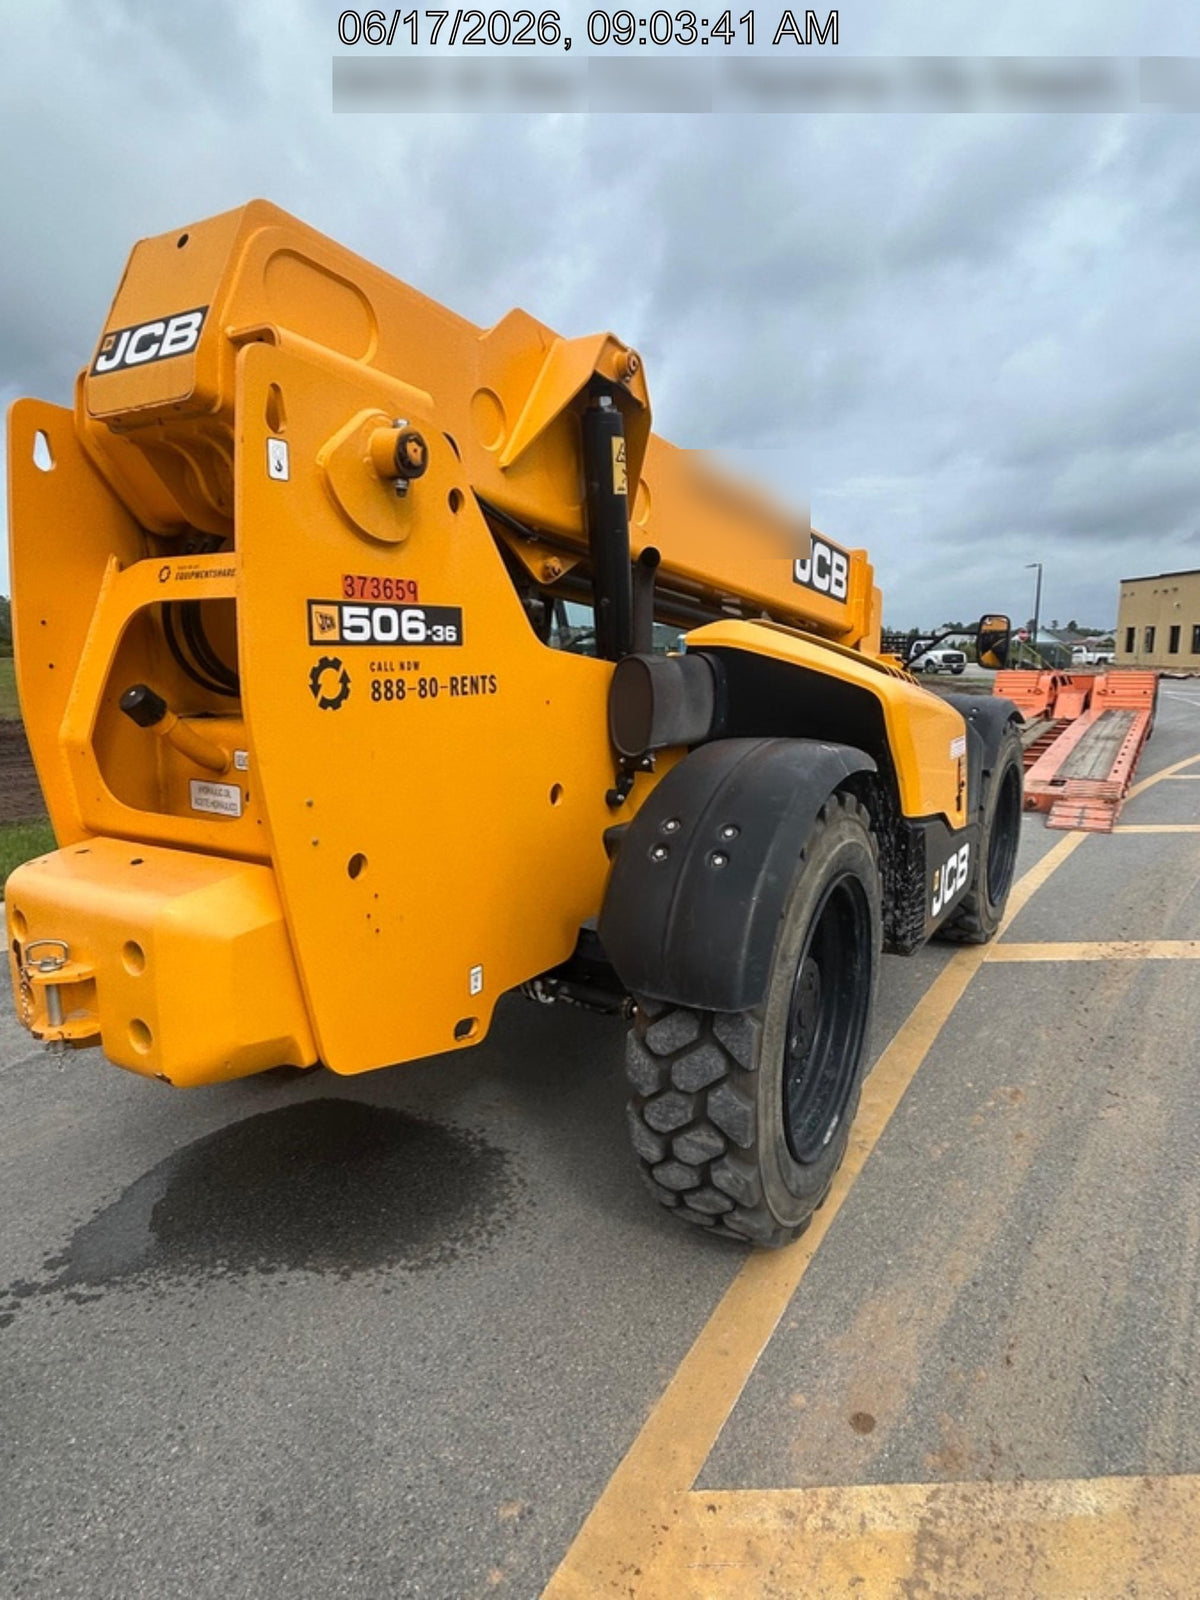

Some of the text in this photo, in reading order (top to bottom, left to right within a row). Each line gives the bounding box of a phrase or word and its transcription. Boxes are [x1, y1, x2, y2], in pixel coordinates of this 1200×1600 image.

[95, 311, 203, 372] JCB
[344, 575, 418, 601] 373659
[795, 541, 848, 599] JCB
[369, 661, 420, 673] CALL NOW
[371, 674, 498, 702] 888-80-RENTS
[931, 842, 970, 917] JCB
